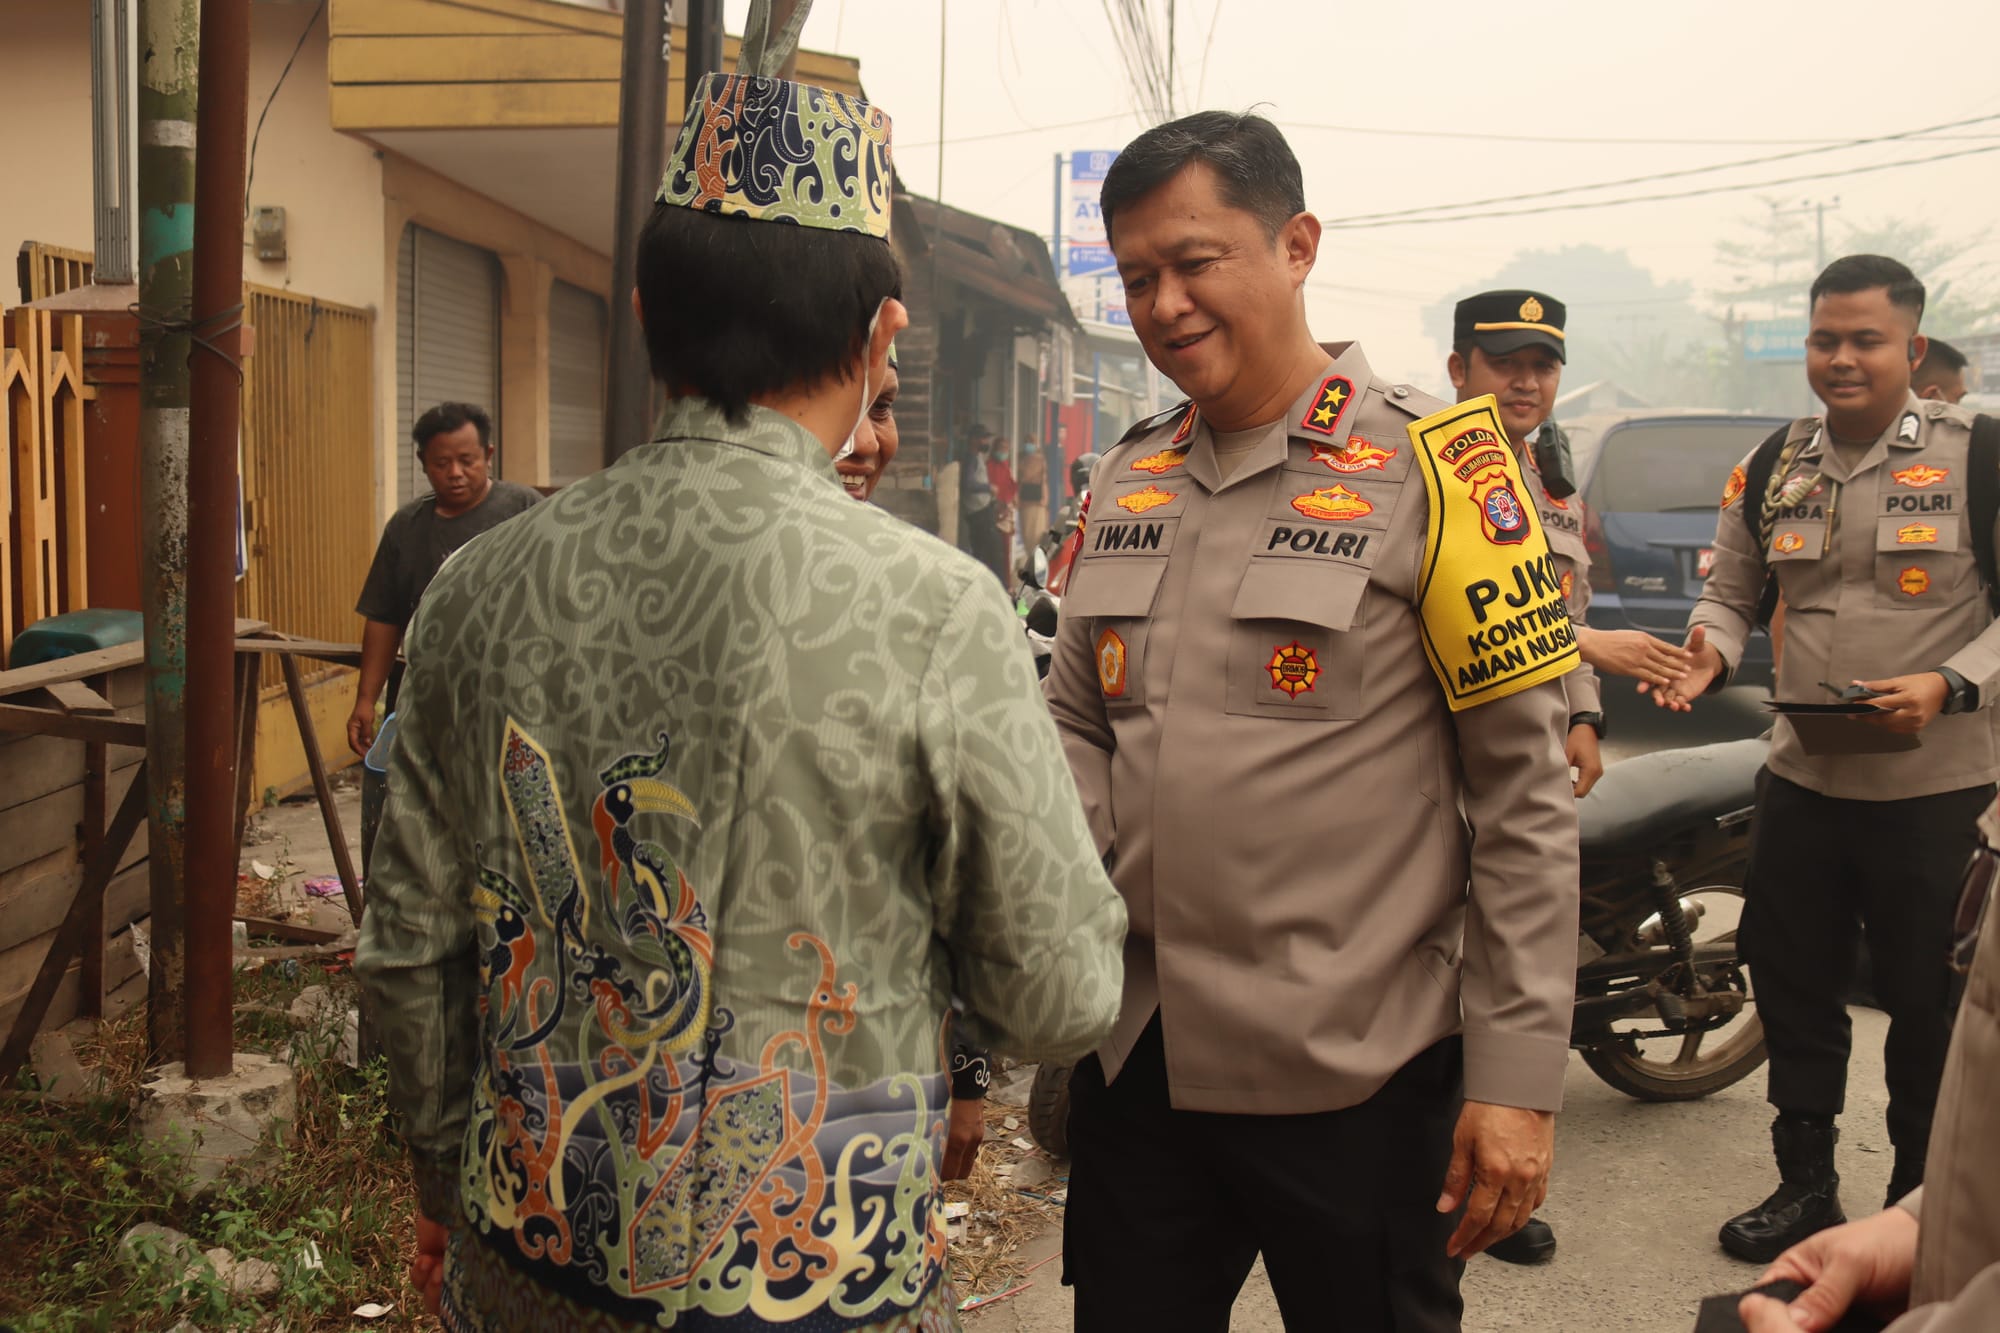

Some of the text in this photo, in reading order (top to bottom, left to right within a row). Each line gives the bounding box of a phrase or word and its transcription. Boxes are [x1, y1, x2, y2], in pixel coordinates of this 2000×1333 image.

[1075, 203, 1101, 218] AT
[1445, 431, 1495, 459] POLDA
[1775, 504, 1823, 519] RGA
[1887, 494, 1952, 512] POLRI
[1542, 510, 1578, 532] POLRI
[1095, 524, 1164, 551] IWAN
[1267, 527, 1369, 559] POLRI
[1458, 645, 1526, 688] AMAN
